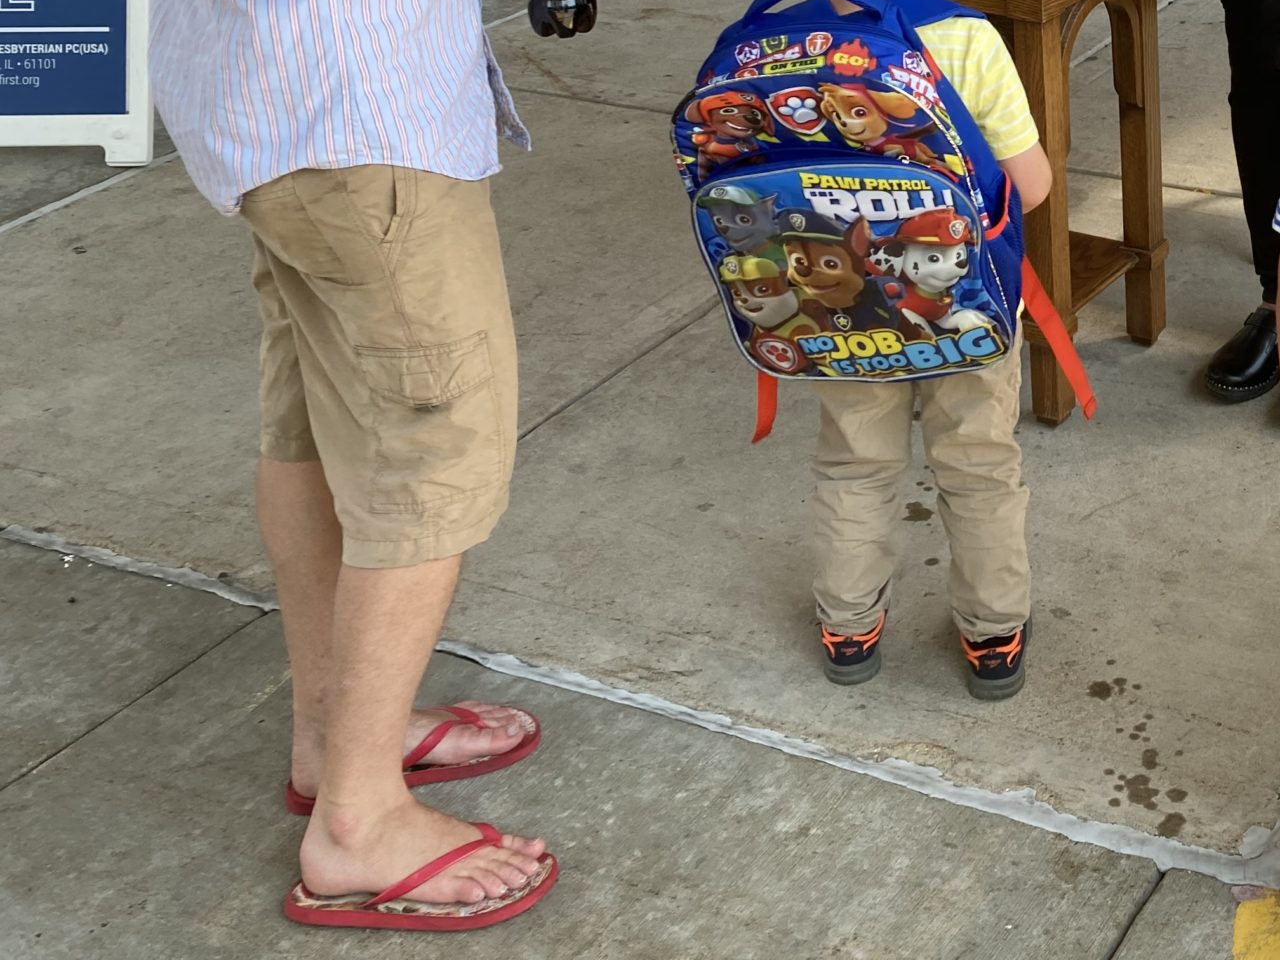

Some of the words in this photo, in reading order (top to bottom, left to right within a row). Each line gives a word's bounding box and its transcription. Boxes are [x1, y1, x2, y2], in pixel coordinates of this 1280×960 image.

[65, 43, 108, 55] PC(USA)
[4, 58, 15, 70] IL
[24, 58, 56, 70] 61101
[770, 62, 788, 71] ON
[790, 58, 818, 68] THE
[833, 52, 870, 67] GO!
[799, 172, 861, 190] PAW
[863, 178, 931, 190] PATROL
[803, 188, 954, 223] ROLL!
[798, 335, 834, 354] NO
[831, 331, 902, 360] JOB
[829, 360, 856, 374] IS
[857, 354, 907, 372] TOO
[903, 326, 997, 370] BIG
